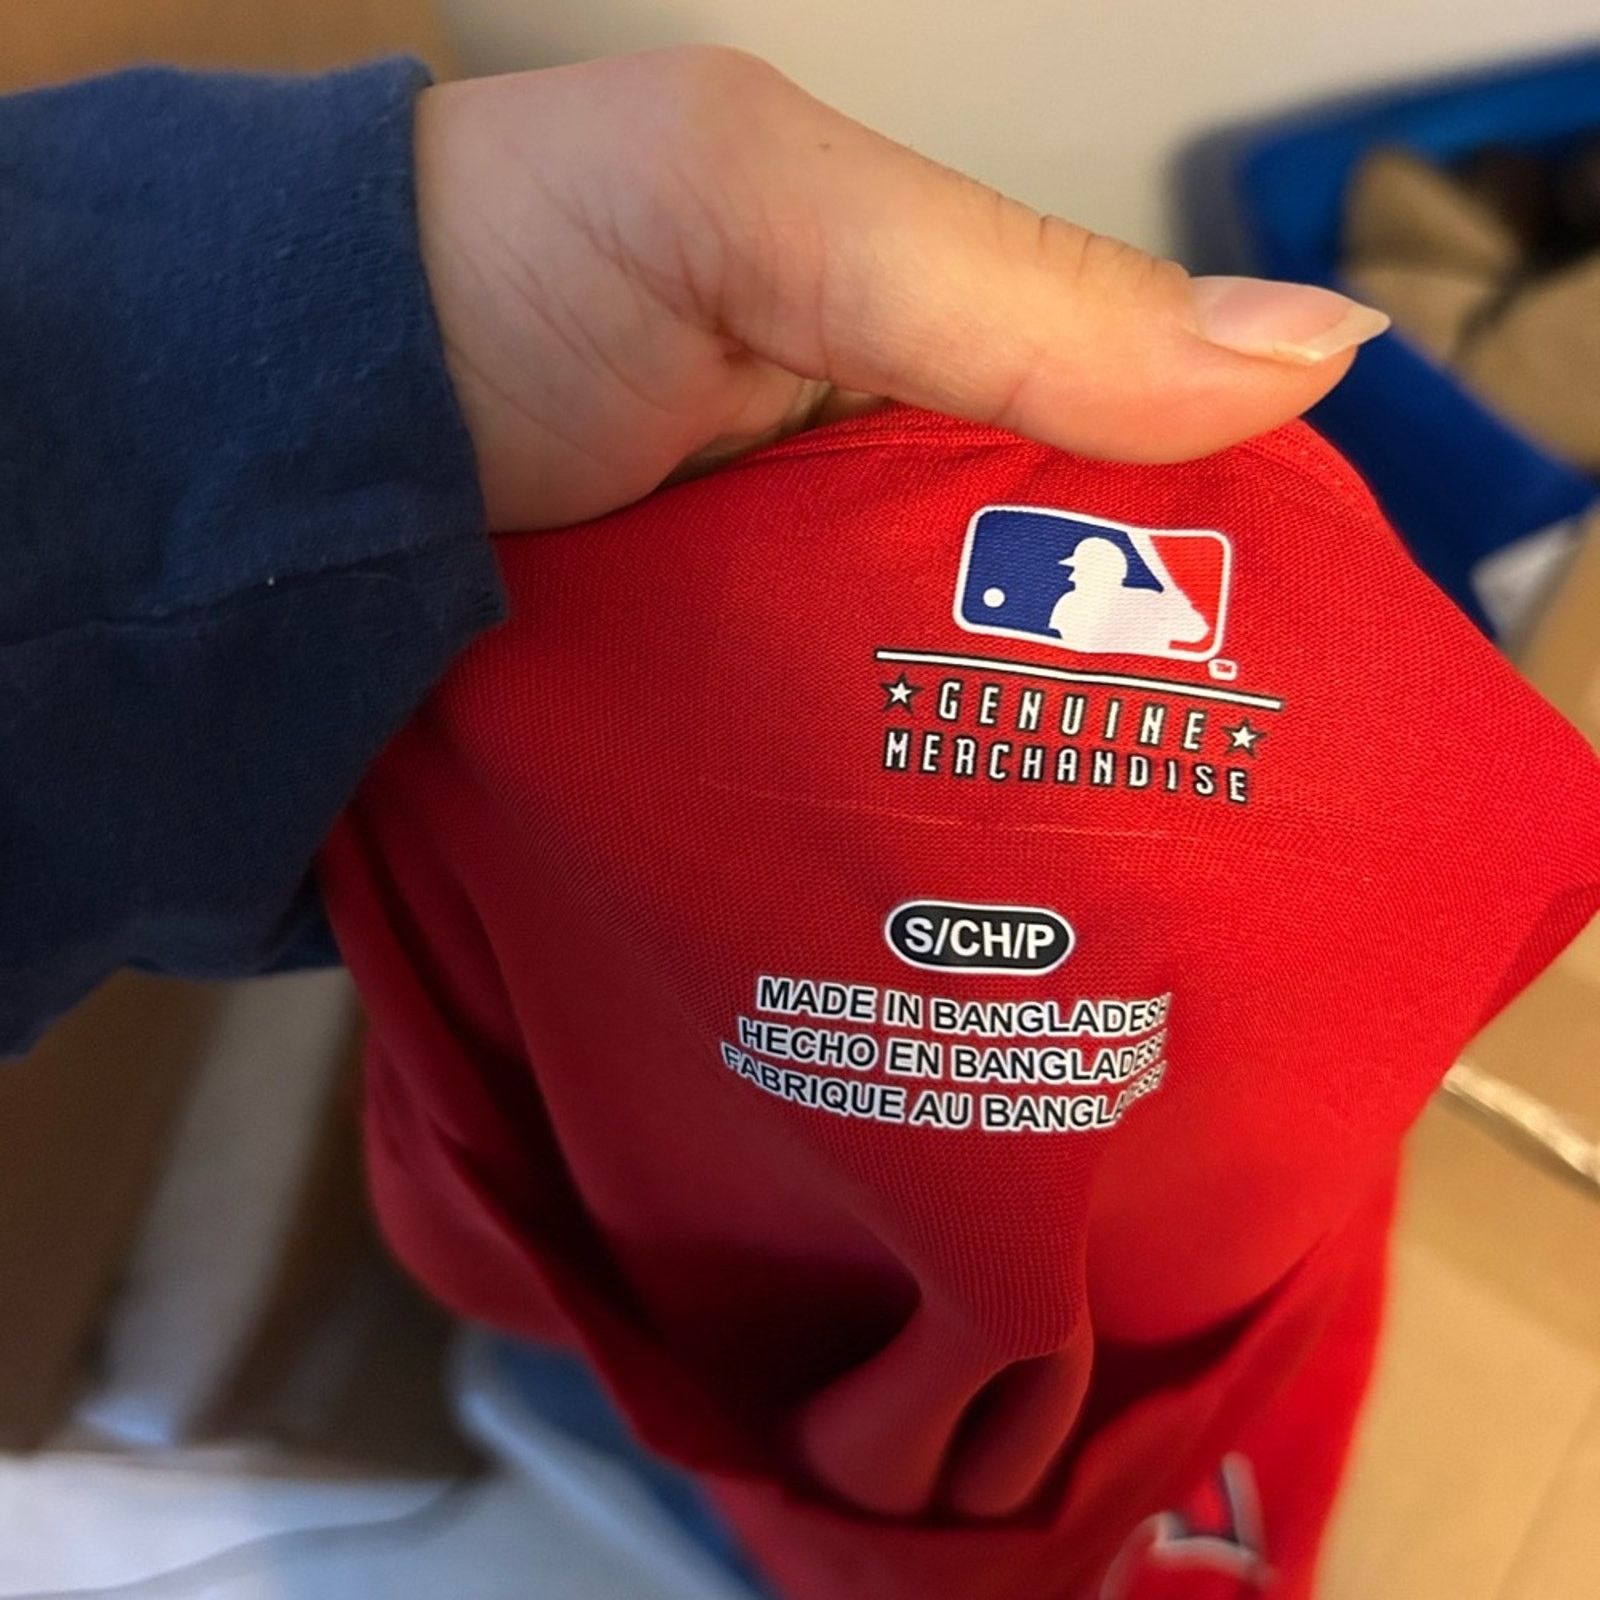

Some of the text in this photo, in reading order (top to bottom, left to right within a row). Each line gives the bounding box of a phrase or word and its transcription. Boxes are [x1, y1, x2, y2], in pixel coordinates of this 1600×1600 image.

[938, 680, 1206, 752] GENUINE
[883, 731, 1249, 803] MERCHANDISE
[904, 916, 1056, 961] S/CH/P
[758, 976, 875, 1021] MADE
[885, 991, 921, 1026] IN
[739, 1017, 878, 1070] HECHO
[888, 1039, 942, 1080] EN
[721, 1043, 904, 1121] FABRIQUE
[913, 1090, 970, 1128] AU
